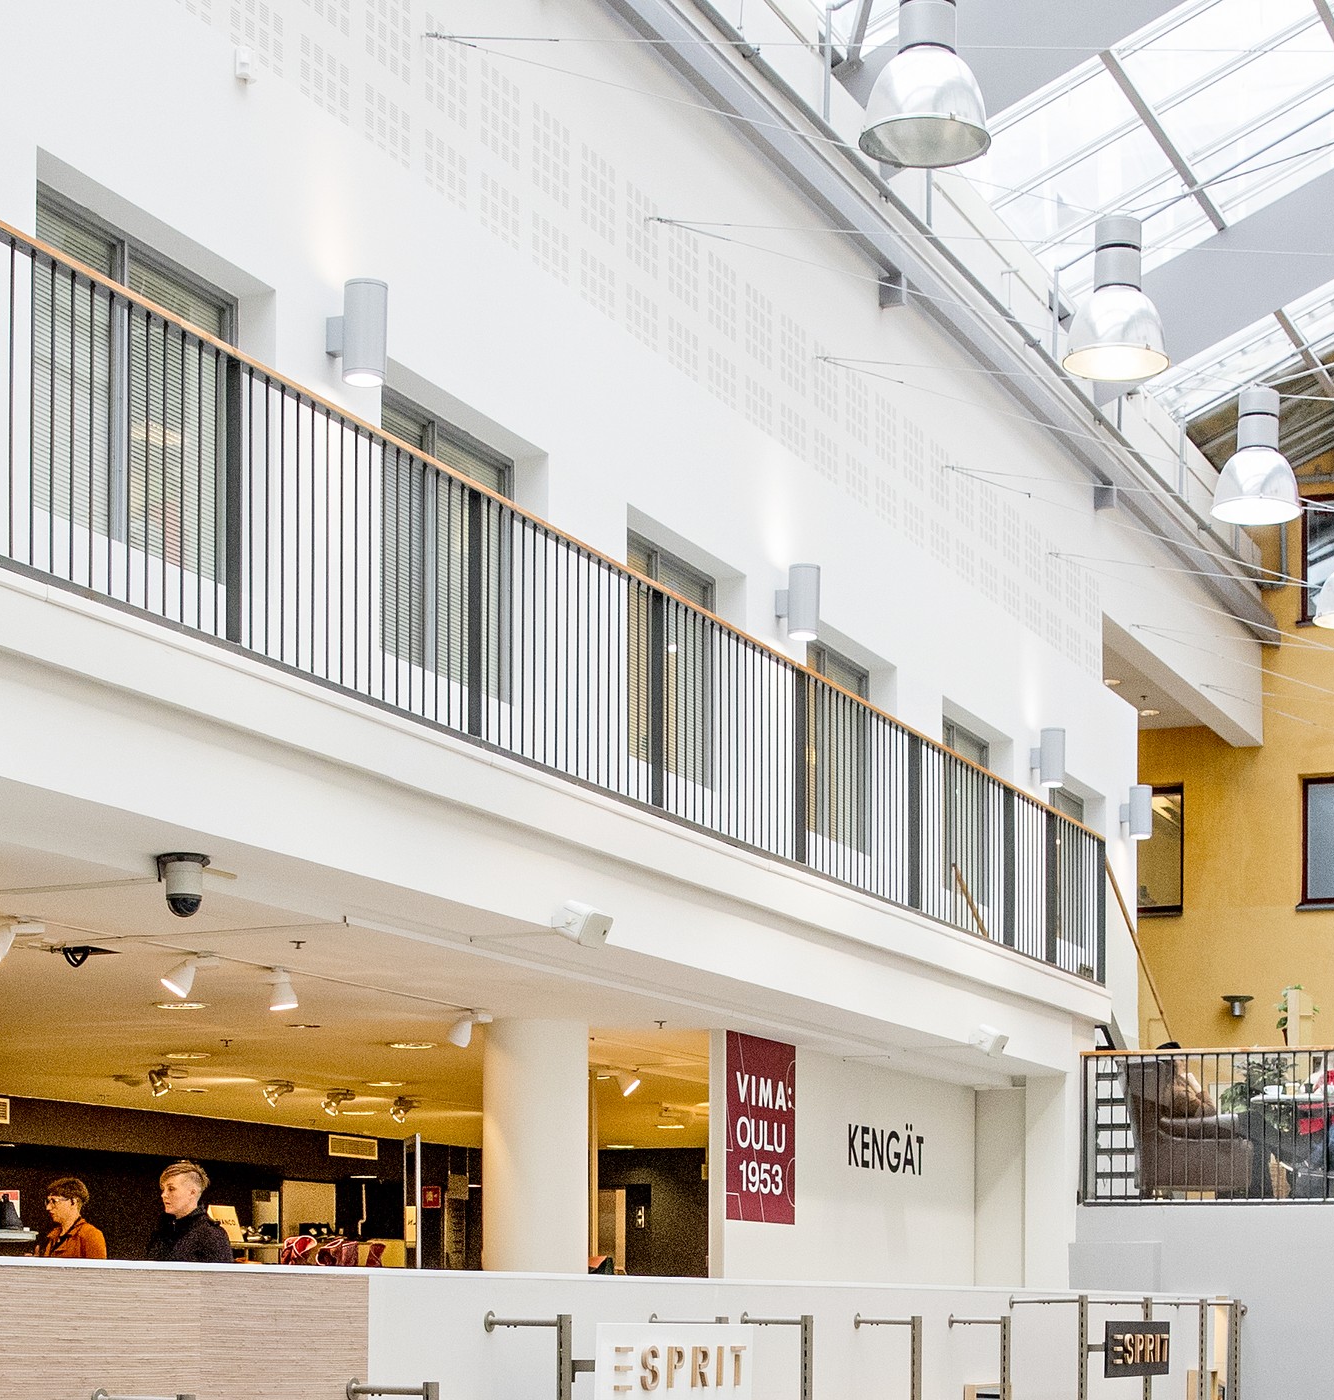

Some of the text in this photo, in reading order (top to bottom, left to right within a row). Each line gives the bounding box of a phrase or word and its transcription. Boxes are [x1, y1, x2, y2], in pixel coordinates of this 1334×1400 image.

[736, 1071, 792, 1112] VIMA:
[736, 1116, 786, 1153] OULU
[848, 1123, 924, 1176] KENGÄT
[739, 1159, 783, 1195] 1953
[613, 1345, 747, 1392] ESPRIT
[1113, 1333, 1169, 1365] ESPRIT
